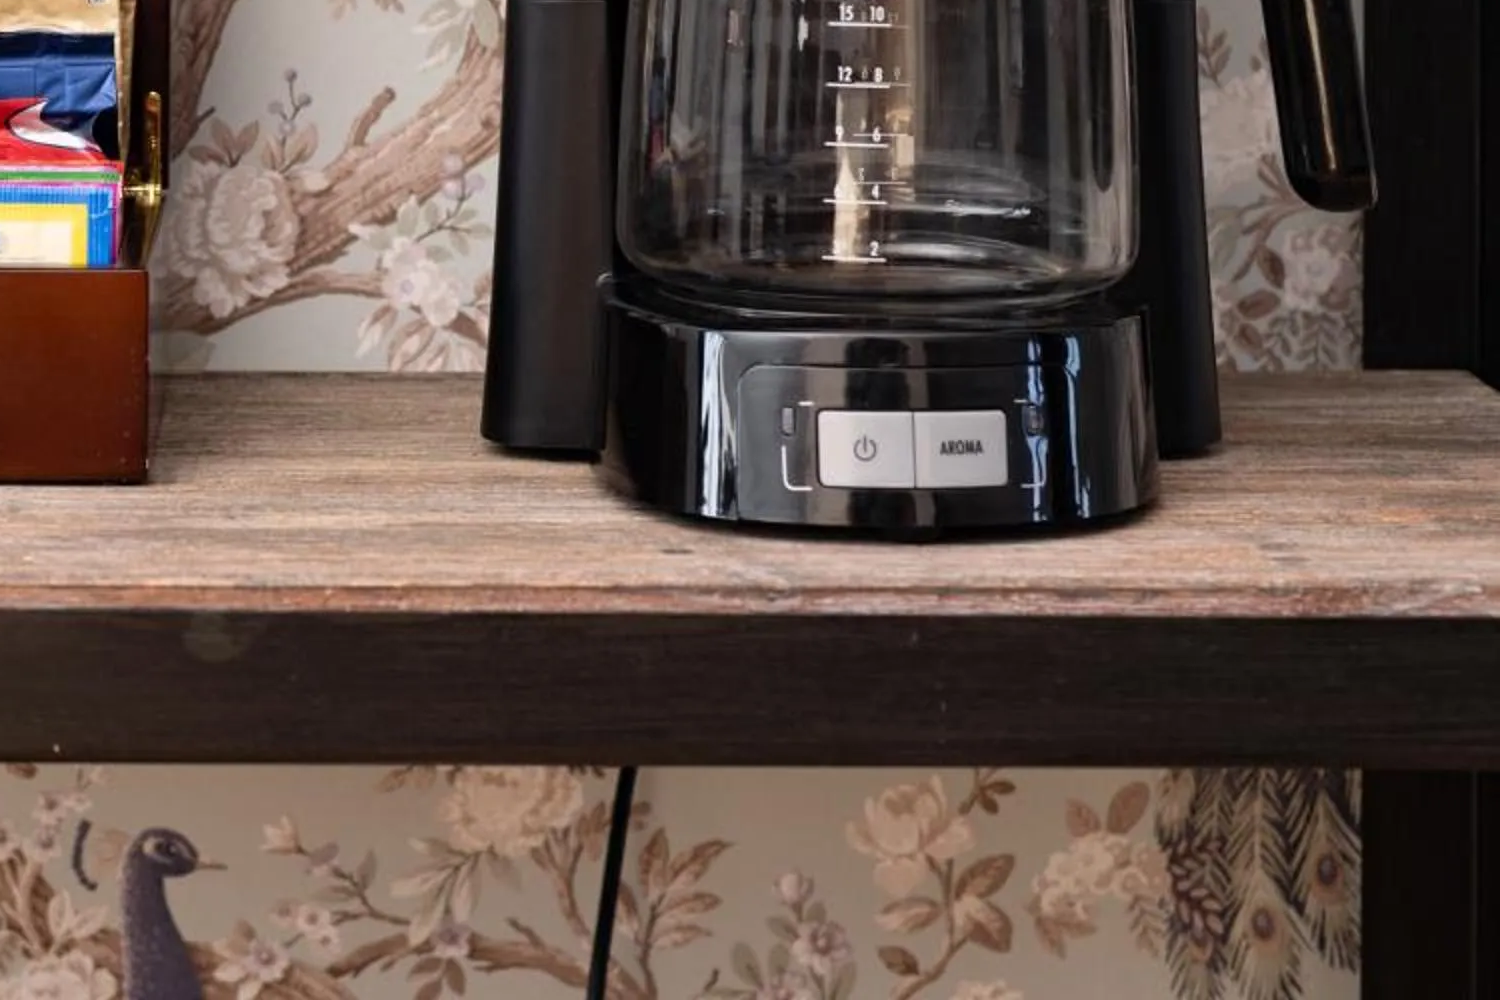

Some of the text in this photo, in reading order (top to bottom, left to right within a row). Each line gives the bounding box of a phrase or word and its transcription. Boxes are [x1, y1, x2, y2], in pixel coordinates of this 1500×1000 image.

[839, 3, 855, 21] 15
[869, 5, 885, 22] 10
[837, 65, 853, 82] 12
[874, 66, 883, 83] 8
[872, 127, 881, 142] 6
[870, 241, 879, 256] 2
[940, 440, 983, 455] AROMA
